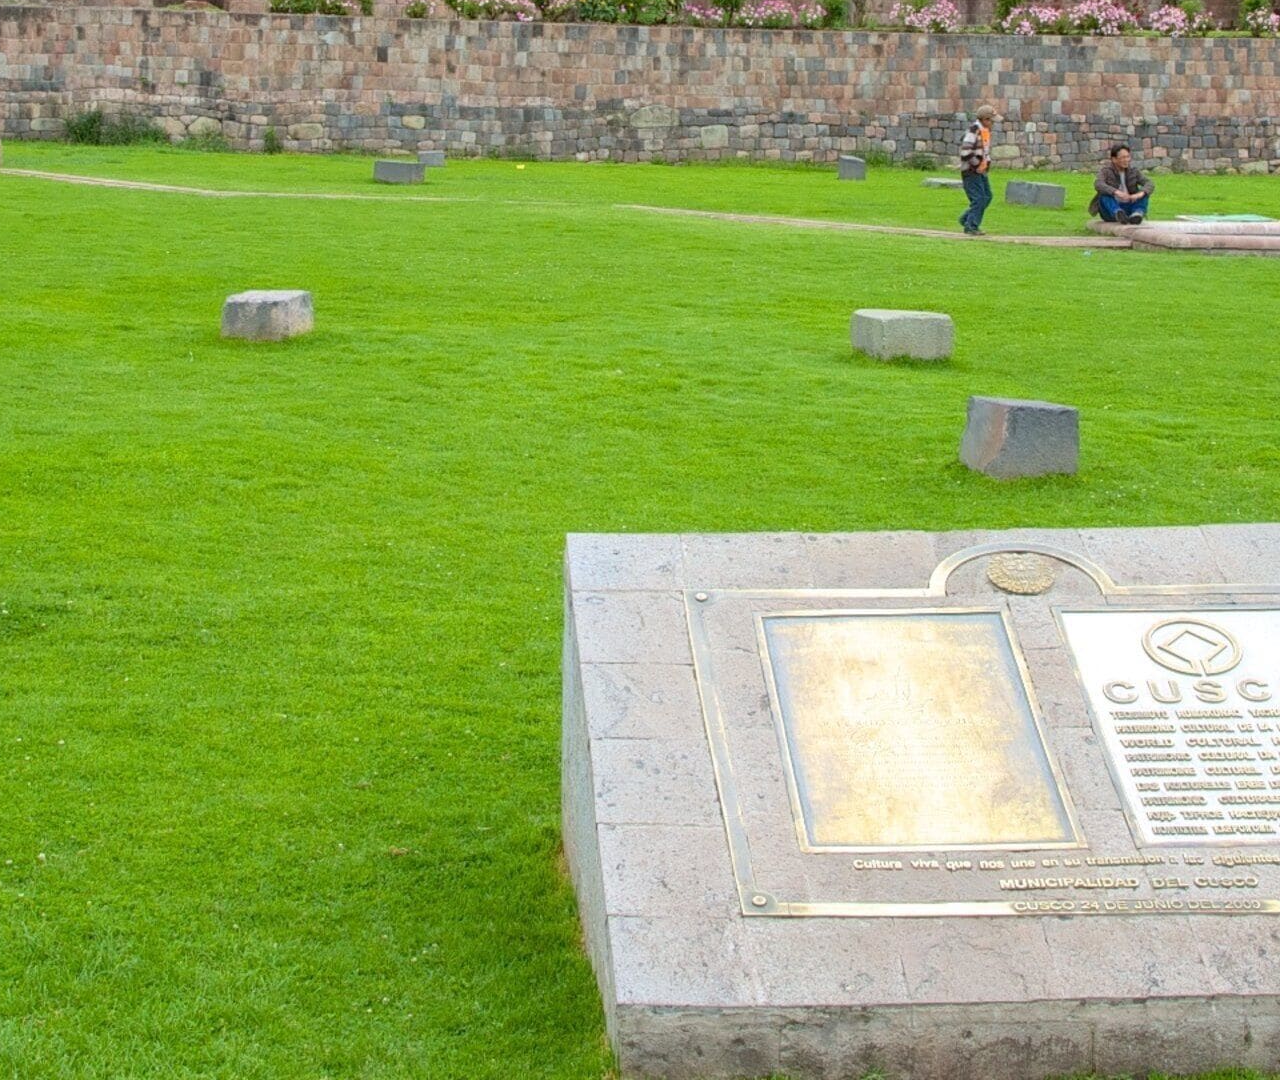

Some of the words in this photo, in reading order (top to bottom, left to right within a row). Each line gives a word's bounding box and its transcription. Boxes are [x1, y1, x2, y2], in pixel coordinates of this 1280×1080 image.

[1237, 723, 1254, 733] DE
[1120, 739, 1175, 748] WORLD
[1185, 738, 1262, 747] CULTURAL
[853, 859, 902, 870] Cultura
[911, 859, 939, 869] viva
[946, 860, 971, 871] que
[979, 860, 1005, 869] nos
[1011, 860, 1036, 869] une
[1042, 858, 1059, 867] en
[999, 877, 1140, 890] MUNICIPALIDAD
[1152, 877, 1189, 889] DEL
[1194, 876, 1259, 888] CUSCO
[1014, 901, 1076, 912] CUSCO
[1081, 901, 1100, 911] 24
[1104, 901, 1129, 911] DE
[1135, 900, 1184, 910] JUNIO
[1187, 899, 1220, 910] DEL
